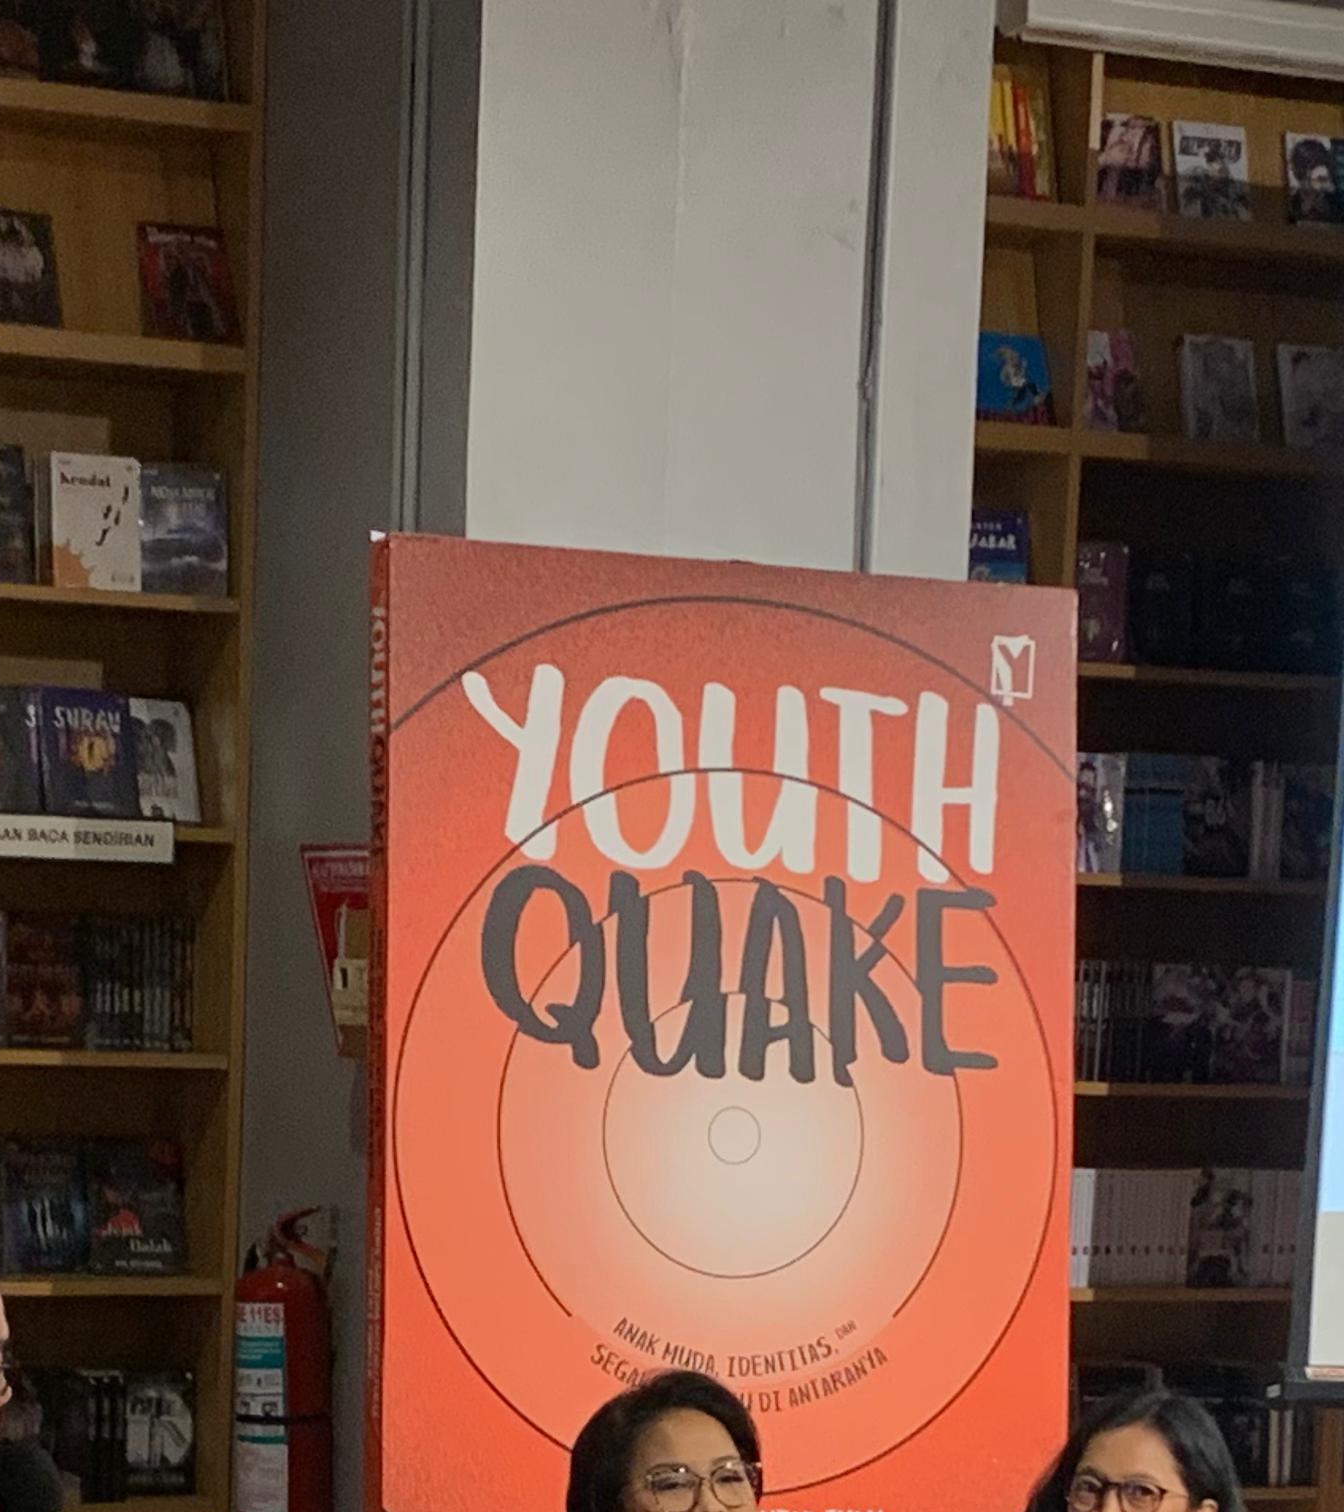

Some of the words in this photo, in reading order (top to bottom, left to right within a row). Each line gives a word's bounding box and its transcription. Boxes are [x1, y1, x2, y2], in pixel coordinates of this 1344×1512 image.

[461, 663, 1001, 883] YOUTH
[27, 828, 69, 845] BACA
[73, 830, 155, 849] SENDIRIAN
[480, 865, 999, 1088] QUAKE
[612, 1316, 664, 1357] ANAK
[660, 1341, 720, 1378] MUDA,
[727, 1335, 839, 1378] IDENTITAS,
[759, 1389, 783, 1413] DI
[788, 1346, 889, 1408] ANTARANYA
